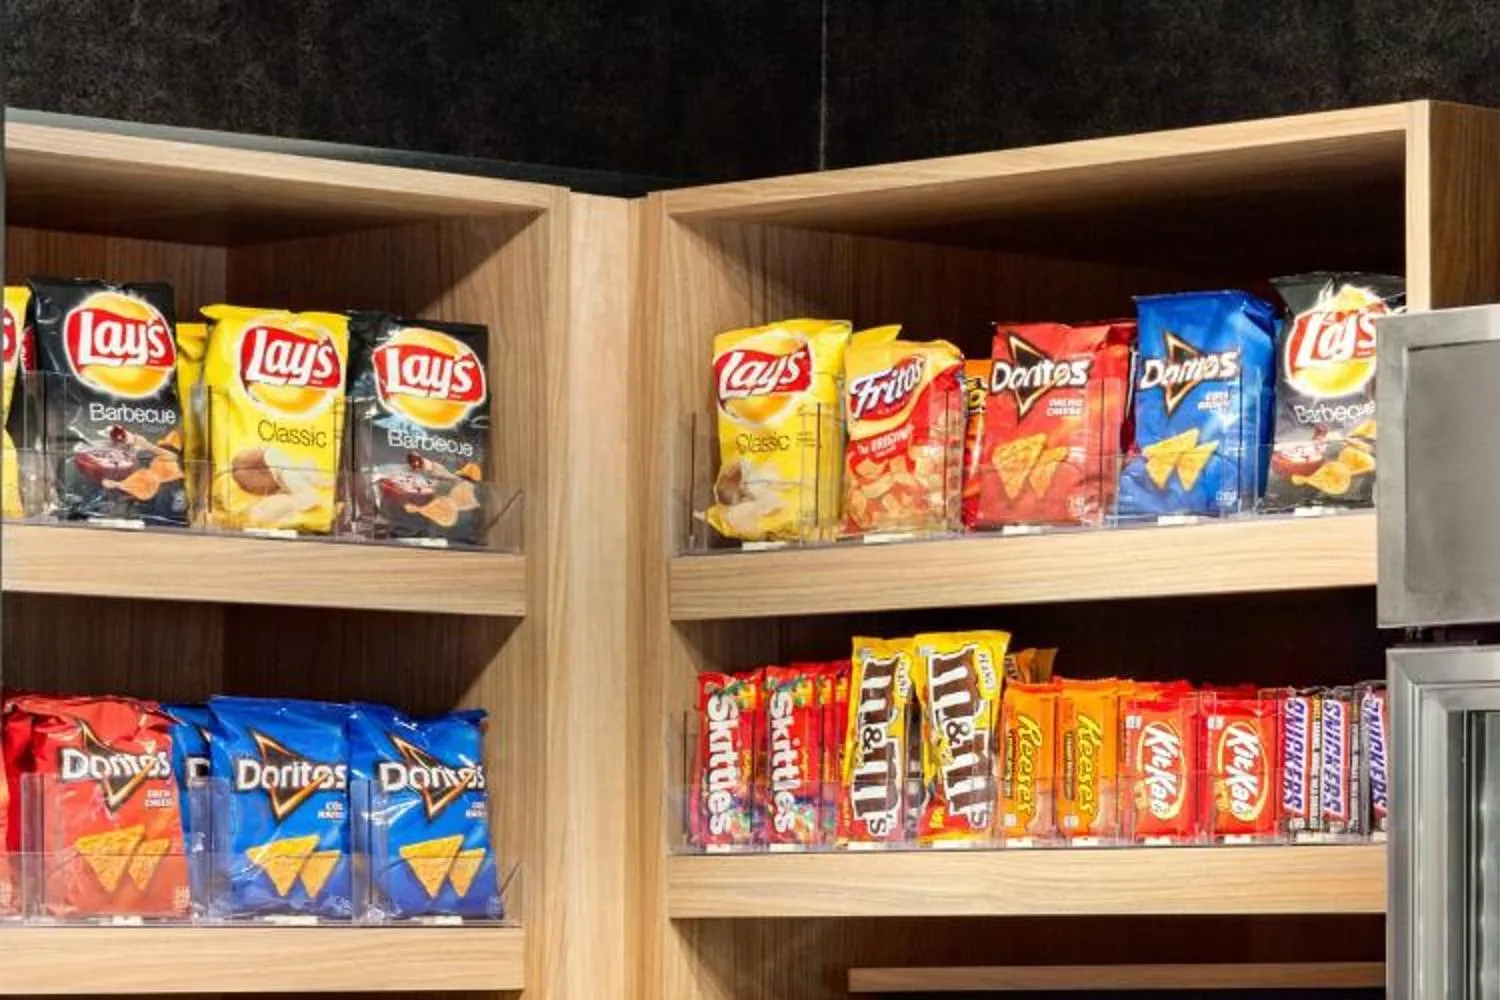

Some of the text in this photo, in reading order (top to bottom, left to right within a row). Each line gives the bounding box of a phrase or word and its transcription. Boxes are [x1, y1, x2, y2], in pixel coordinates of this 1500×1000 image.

[79, 308, 166, 366] Lay's
[246, 329, 334, 384] Lay's
[386, 345, 474, 398] Lay's
[1139, 351, 1240, 389] Doritos
[991, 359, 1091, 392] Doritos
[89, 402, 176, 425] Barbecue
[257, 419, 328, 449] Classic
[388, 429, 474, 458] Barbecue
[735, 431, 791, 455] Classic
[61, 747, 172, 781] Doritos
[707, 693, 739, 835] Skittles
[769, 690, 801, 833] Skittles
[1282, 699, 1305, 809] SNICKERS
[1322, 699, 1342, 813] SNICKERS
[236, 758, 348, 791] Doritos
[378, 762, 486, 792] Doritos
